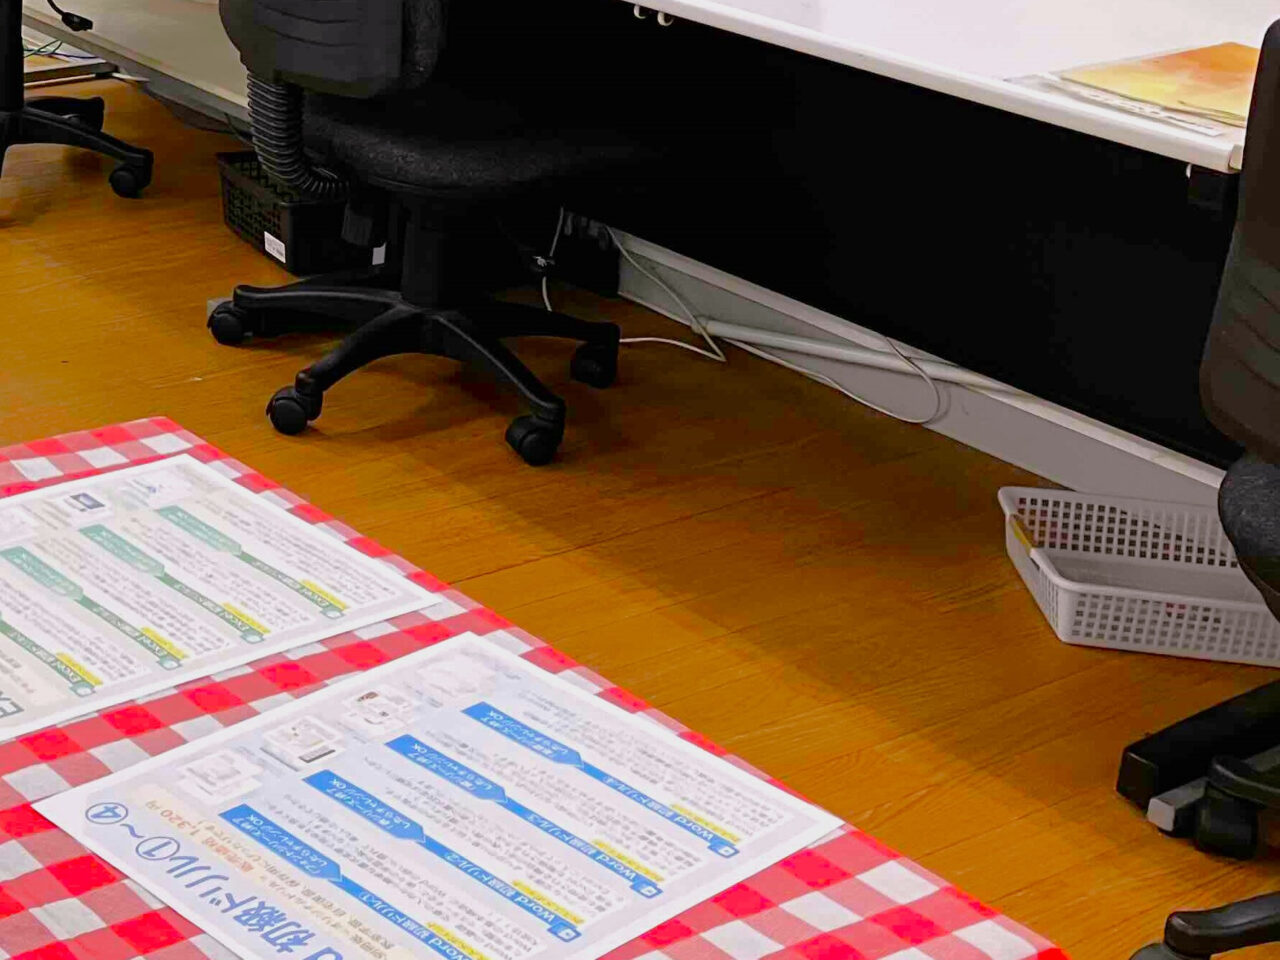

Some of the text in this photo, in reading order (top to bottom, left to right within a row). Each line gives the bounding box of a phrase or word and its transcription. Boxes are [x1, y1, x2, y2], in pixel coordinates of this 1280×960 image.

[672, 814, 716, 840] Word
[593, 852, 639, 879] Word
[512, 894, 559, 922] Word
